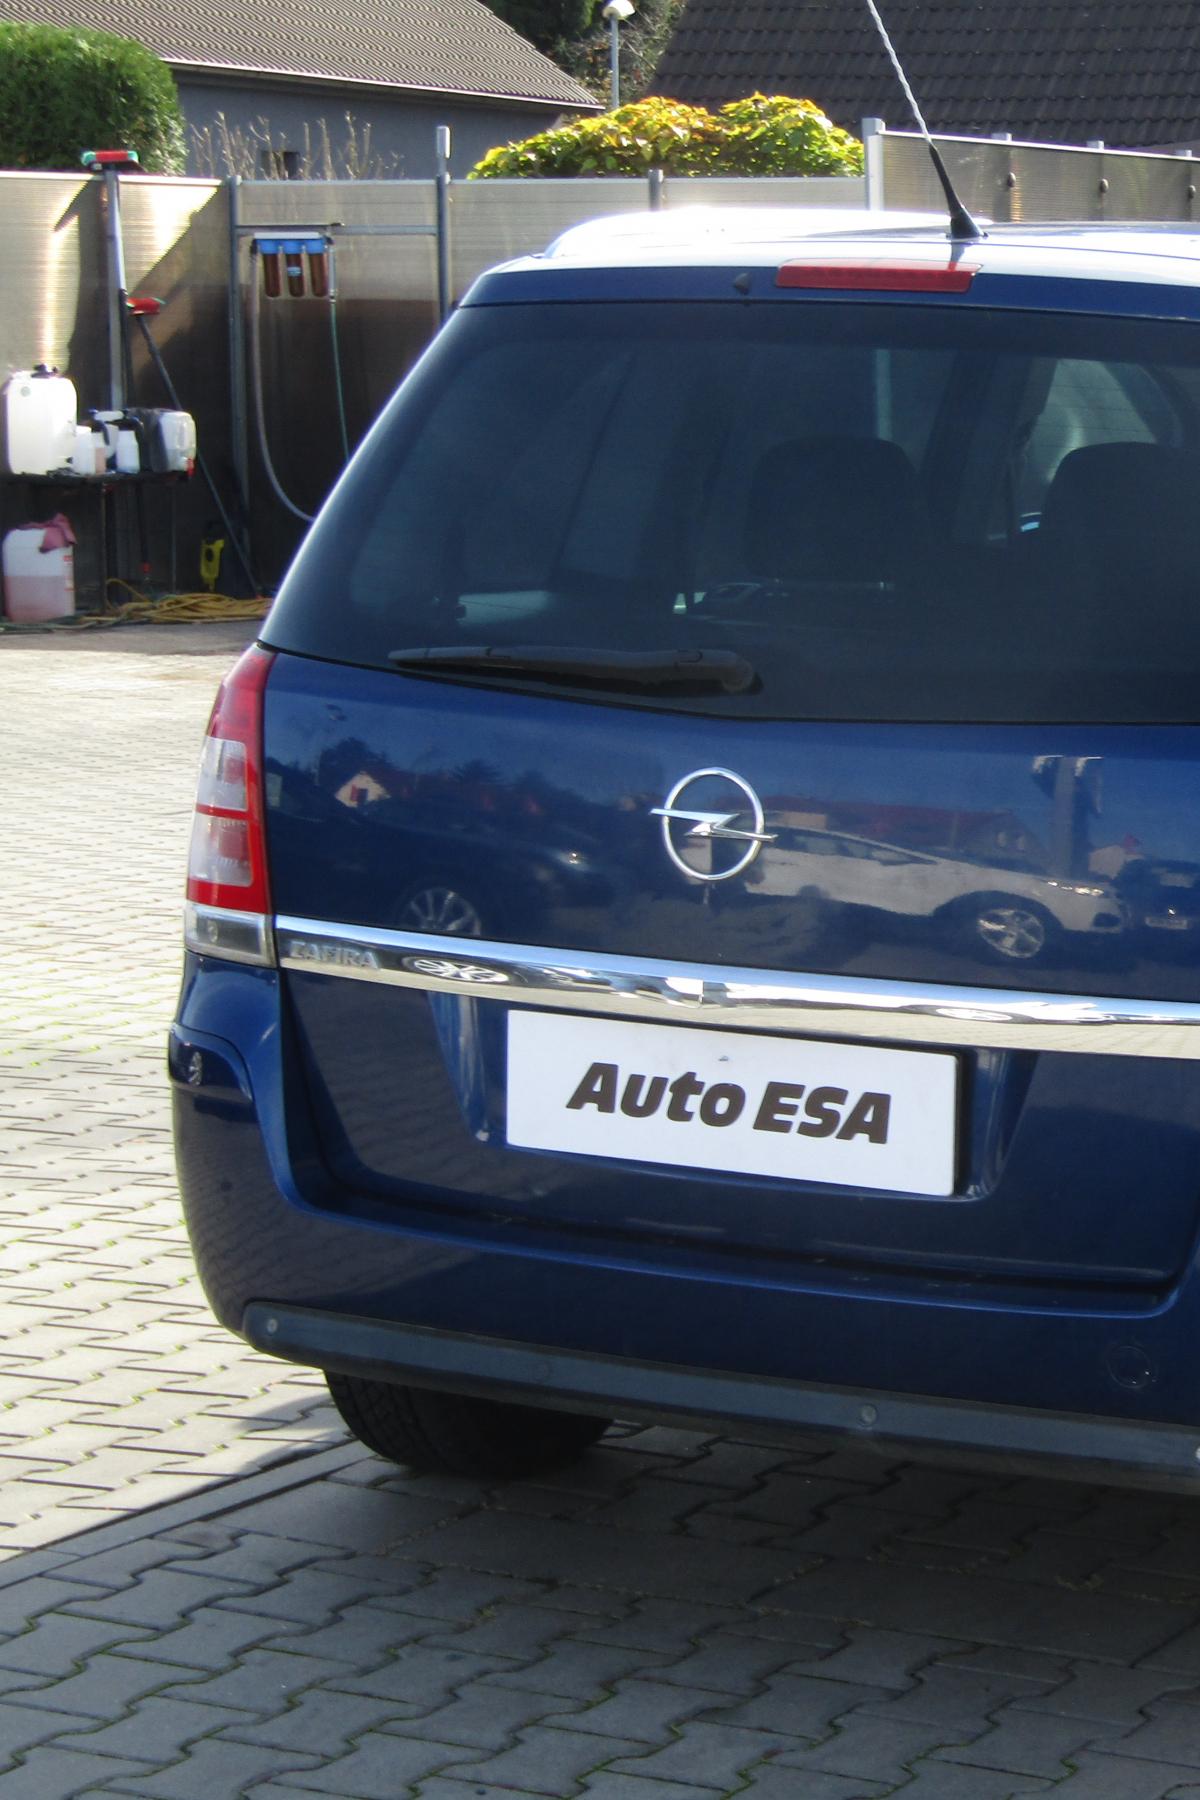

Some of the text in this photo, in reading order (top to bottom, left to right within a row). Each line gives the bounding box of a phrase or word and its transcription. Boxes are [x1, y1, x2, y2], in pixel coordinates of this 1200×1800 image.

[289, 940, 380, 969] ZAFIRA
[566, 1062, 891, 1145] Auto ESA
